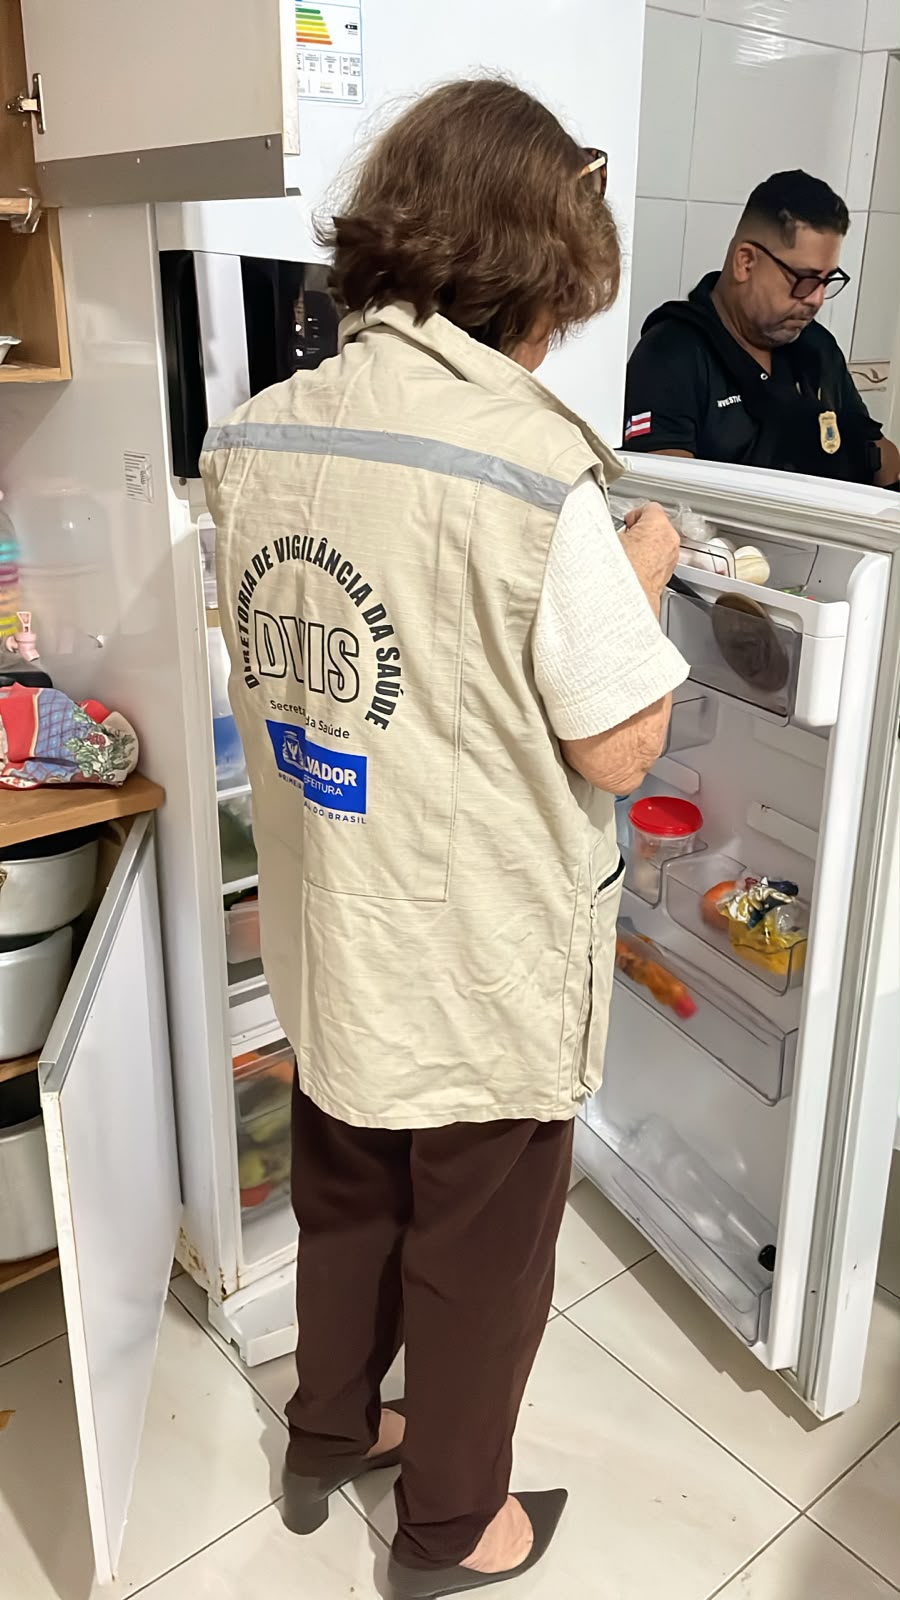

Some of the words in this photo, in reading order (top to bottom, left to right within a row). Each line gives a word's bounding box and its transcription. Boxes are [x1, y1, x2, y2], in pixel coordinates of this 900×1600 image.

[251, 546, 274, 579] DE
[273, 534, 373, 607] VIGILÂNCIA
[362, 603, 395, 642] DA
[254, 609, 360, 703] DVIS
[364, 647, 404, 730] SAÚDE
[318, 720, 350, 739] Saúde
[313, 806, 324, 817] DO
[328, 811, 367, 824] BRASIL
